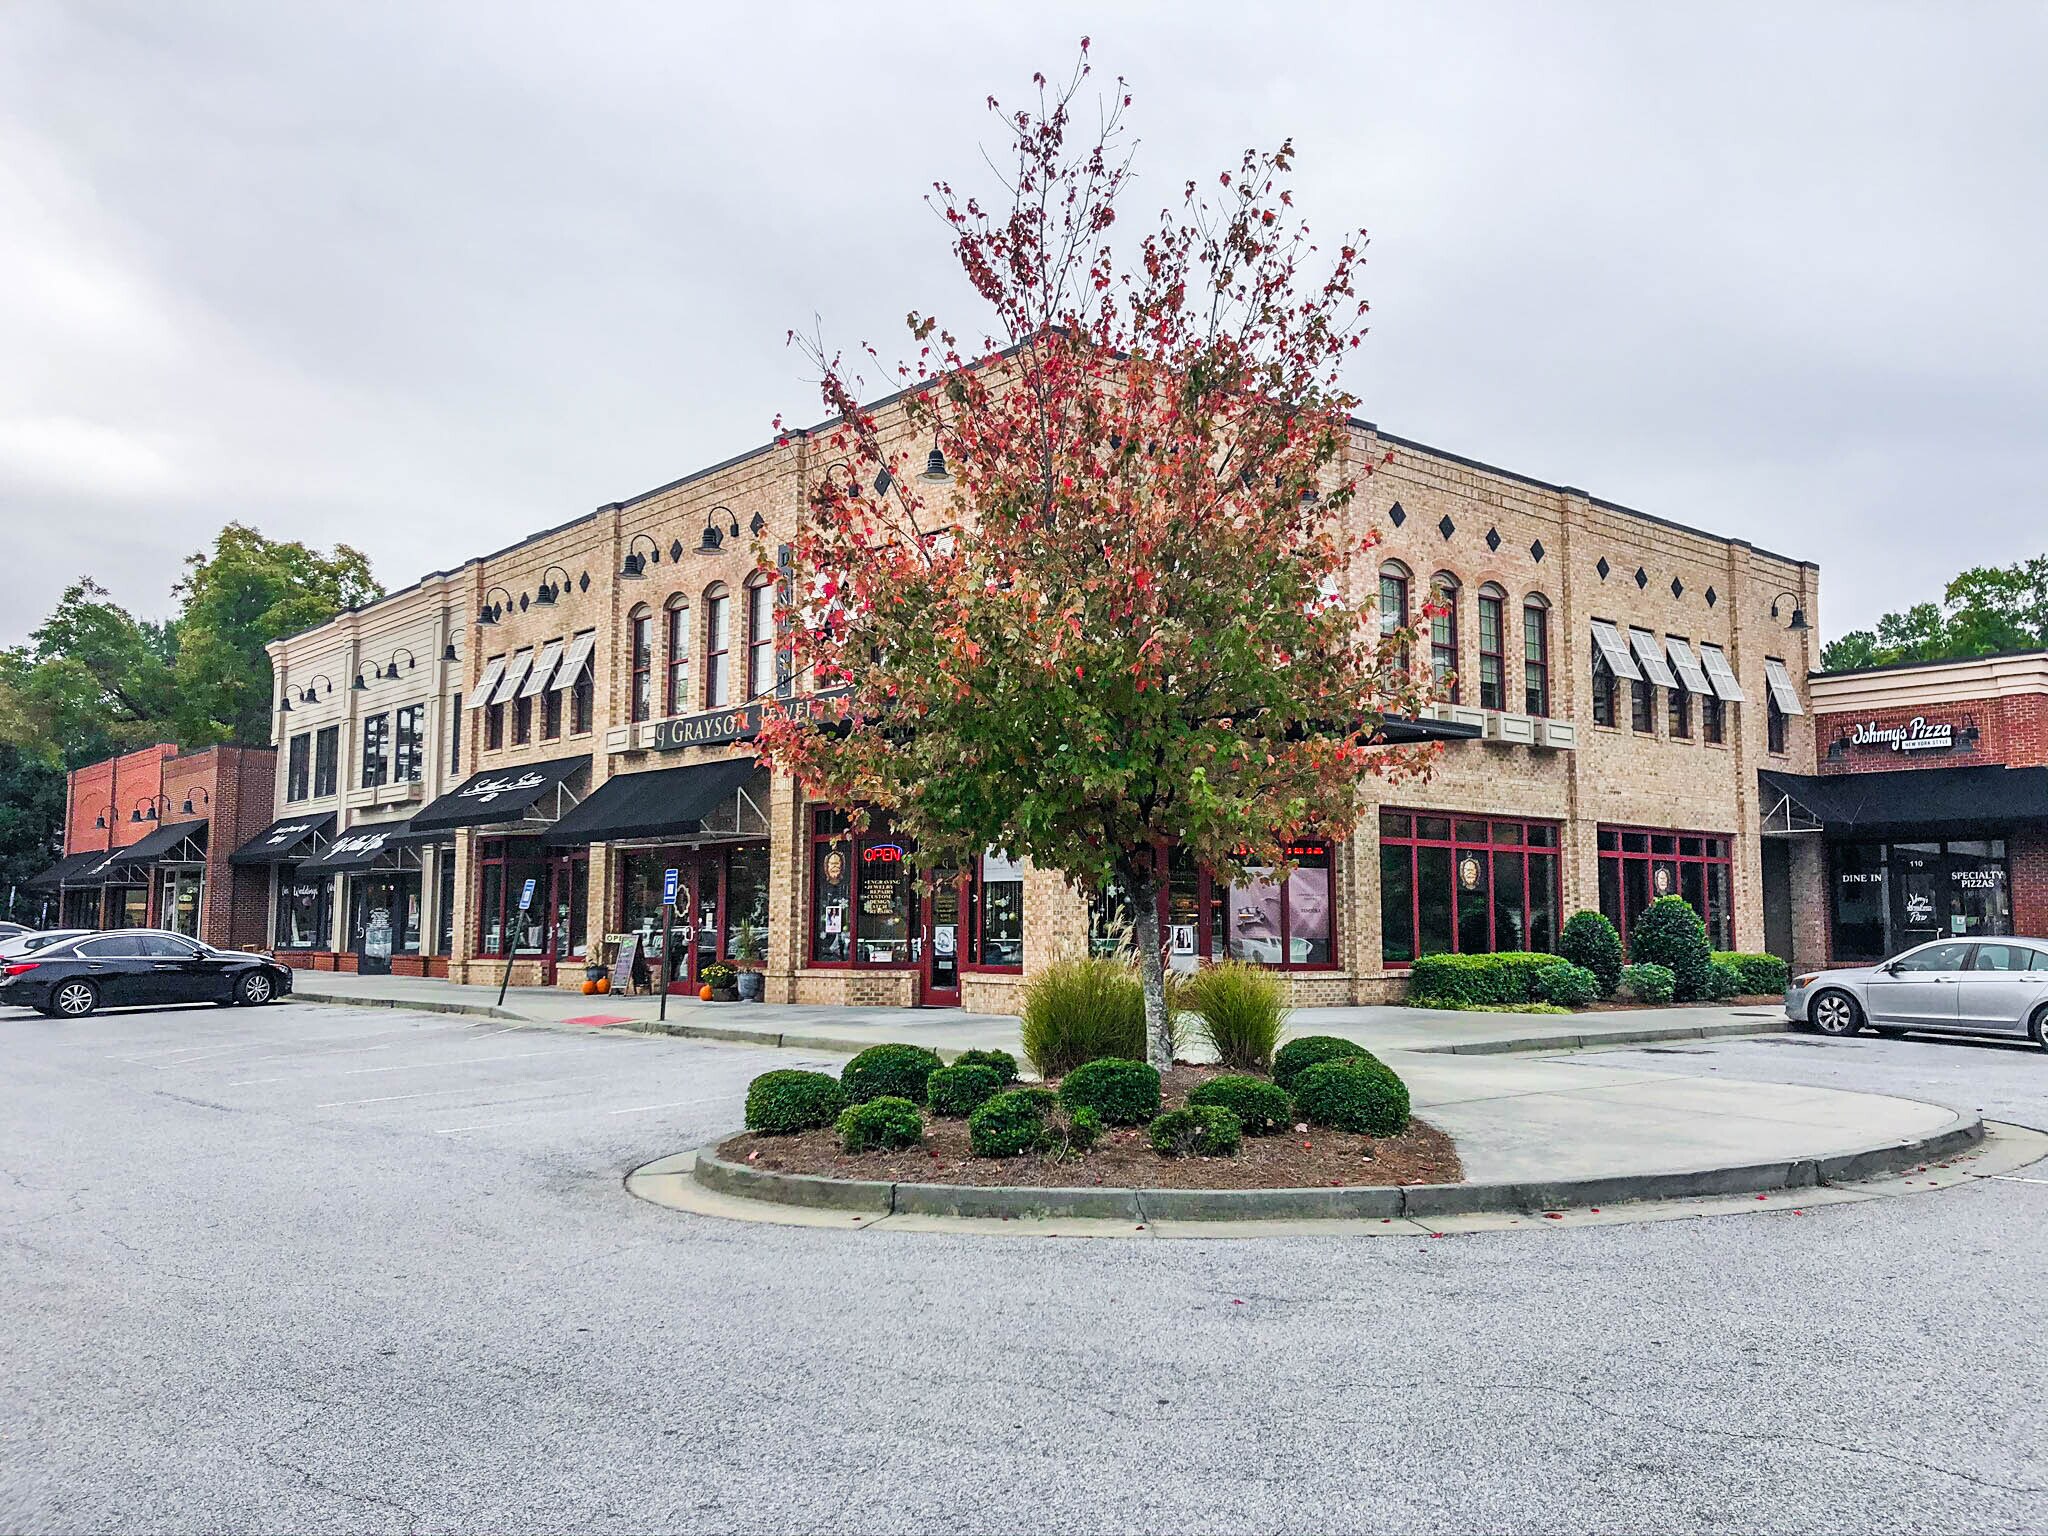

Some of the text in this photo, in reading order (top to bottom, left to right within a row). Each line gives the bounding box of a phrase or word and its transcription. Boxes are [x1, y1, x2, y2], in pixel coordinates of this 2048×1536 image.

[1852, 717, 1952, 751] Johnny's Pizza
[863, 848, 901, 862] OPEN
[1842, 873, 1882, 883] DINE IN
[1951, 871, 2004, 881] SPECIALTY
[1961, 879, 1995, 888] PIZZAS
